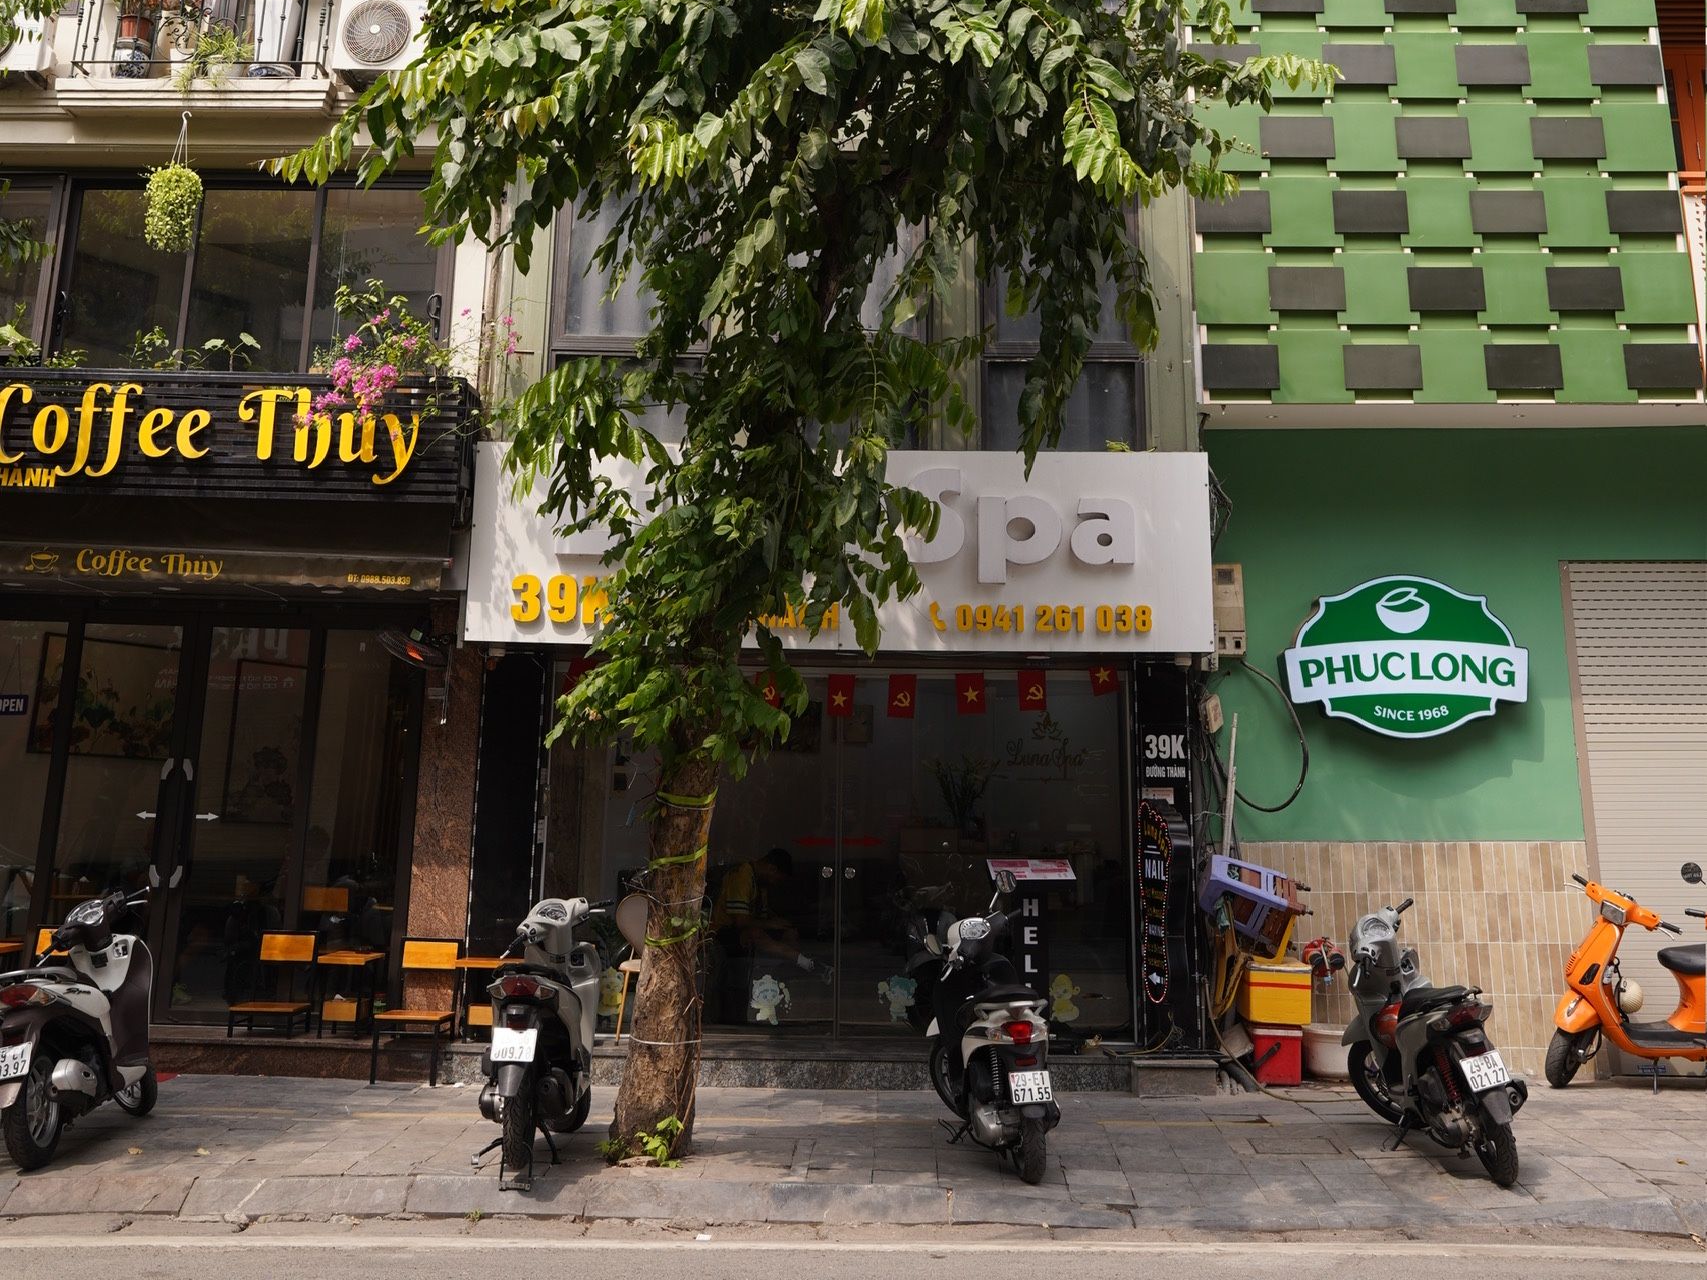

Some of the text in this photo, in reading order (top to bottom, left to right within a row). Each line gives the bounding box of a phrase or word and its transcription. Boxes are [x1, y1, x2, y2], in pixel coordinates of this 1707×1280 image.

[0, 383, 211, 477] Coffee
[906, 468, 1136, 584] Spa
[76, 548, 152, 578] Coffee
[955, 604, 1153, 633] 0941 261 038
[1373, 704, 1450, 721] SINCE 1968
[1144, 734, 1186, 760] 39K
[1144, 858, 1166, 881] NAIL
[1022, 898, 1039, 989] HEL
[1467, 1054, 1498, 1074] 29-BA
[1015, 1072, 1045, 1088] 29-E1
[1469, 1067, 1506, 1089] 021.27
[1013, 1087, 1051, 1103] 671.55
